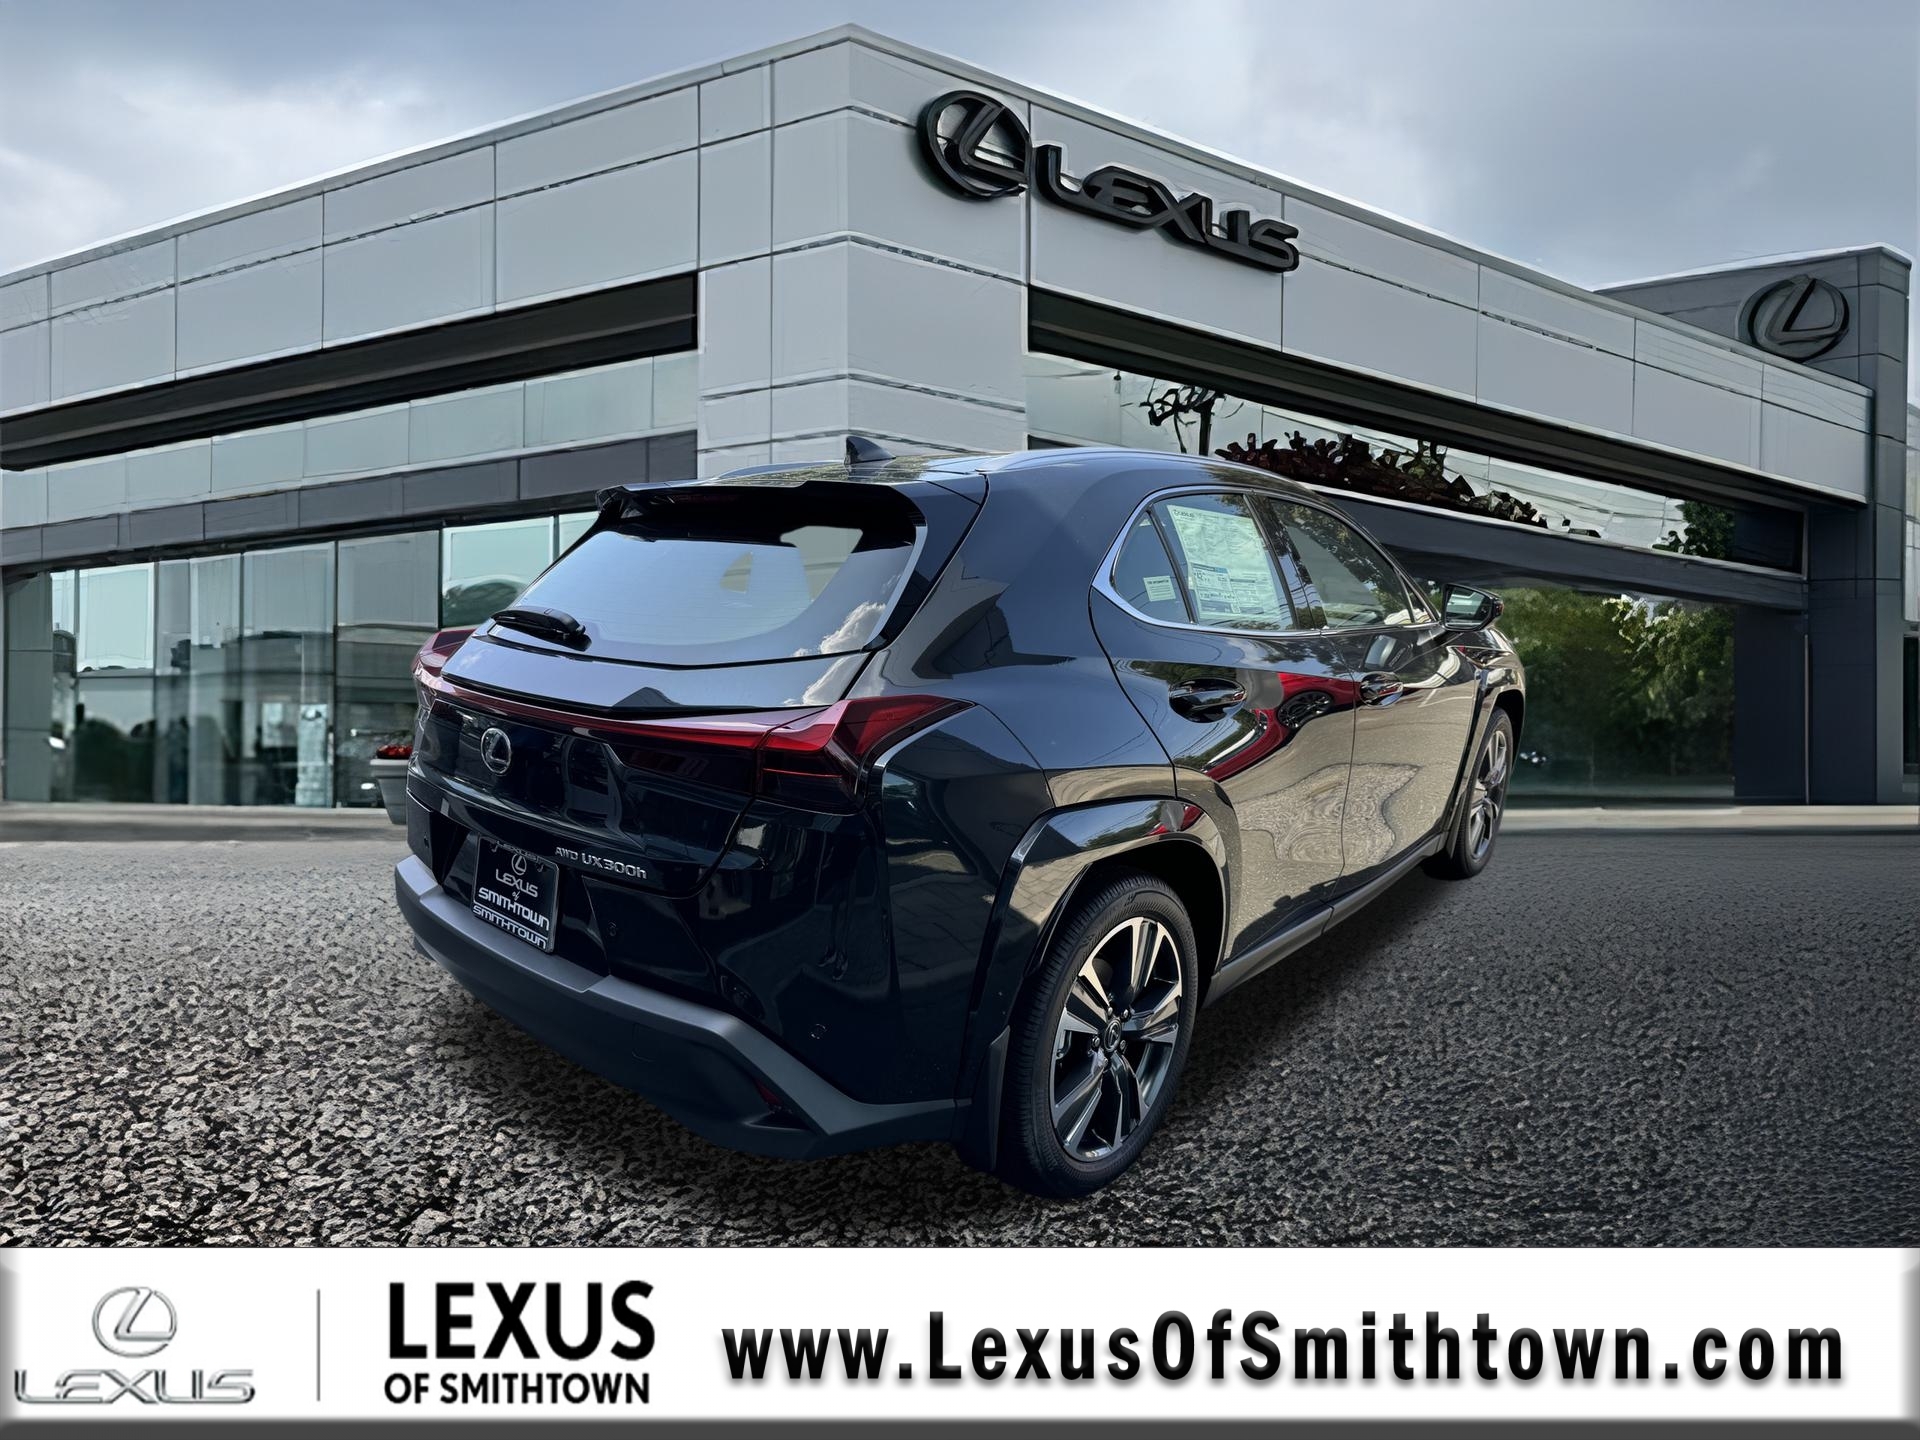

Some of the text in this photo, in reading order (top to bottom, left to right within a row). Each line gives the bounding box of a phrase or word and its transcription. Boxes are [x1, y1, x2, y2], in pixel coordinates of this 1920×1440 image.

[1033, 143, 1300, 273] LEXUS
[495, 868, 538, 898] LEXUS
[555, 846, 647, 879] AWD UX300h
[472, 904, 547, 950] SMITHTOWN
[478, 887, 550, 931] SMITHTOWN
